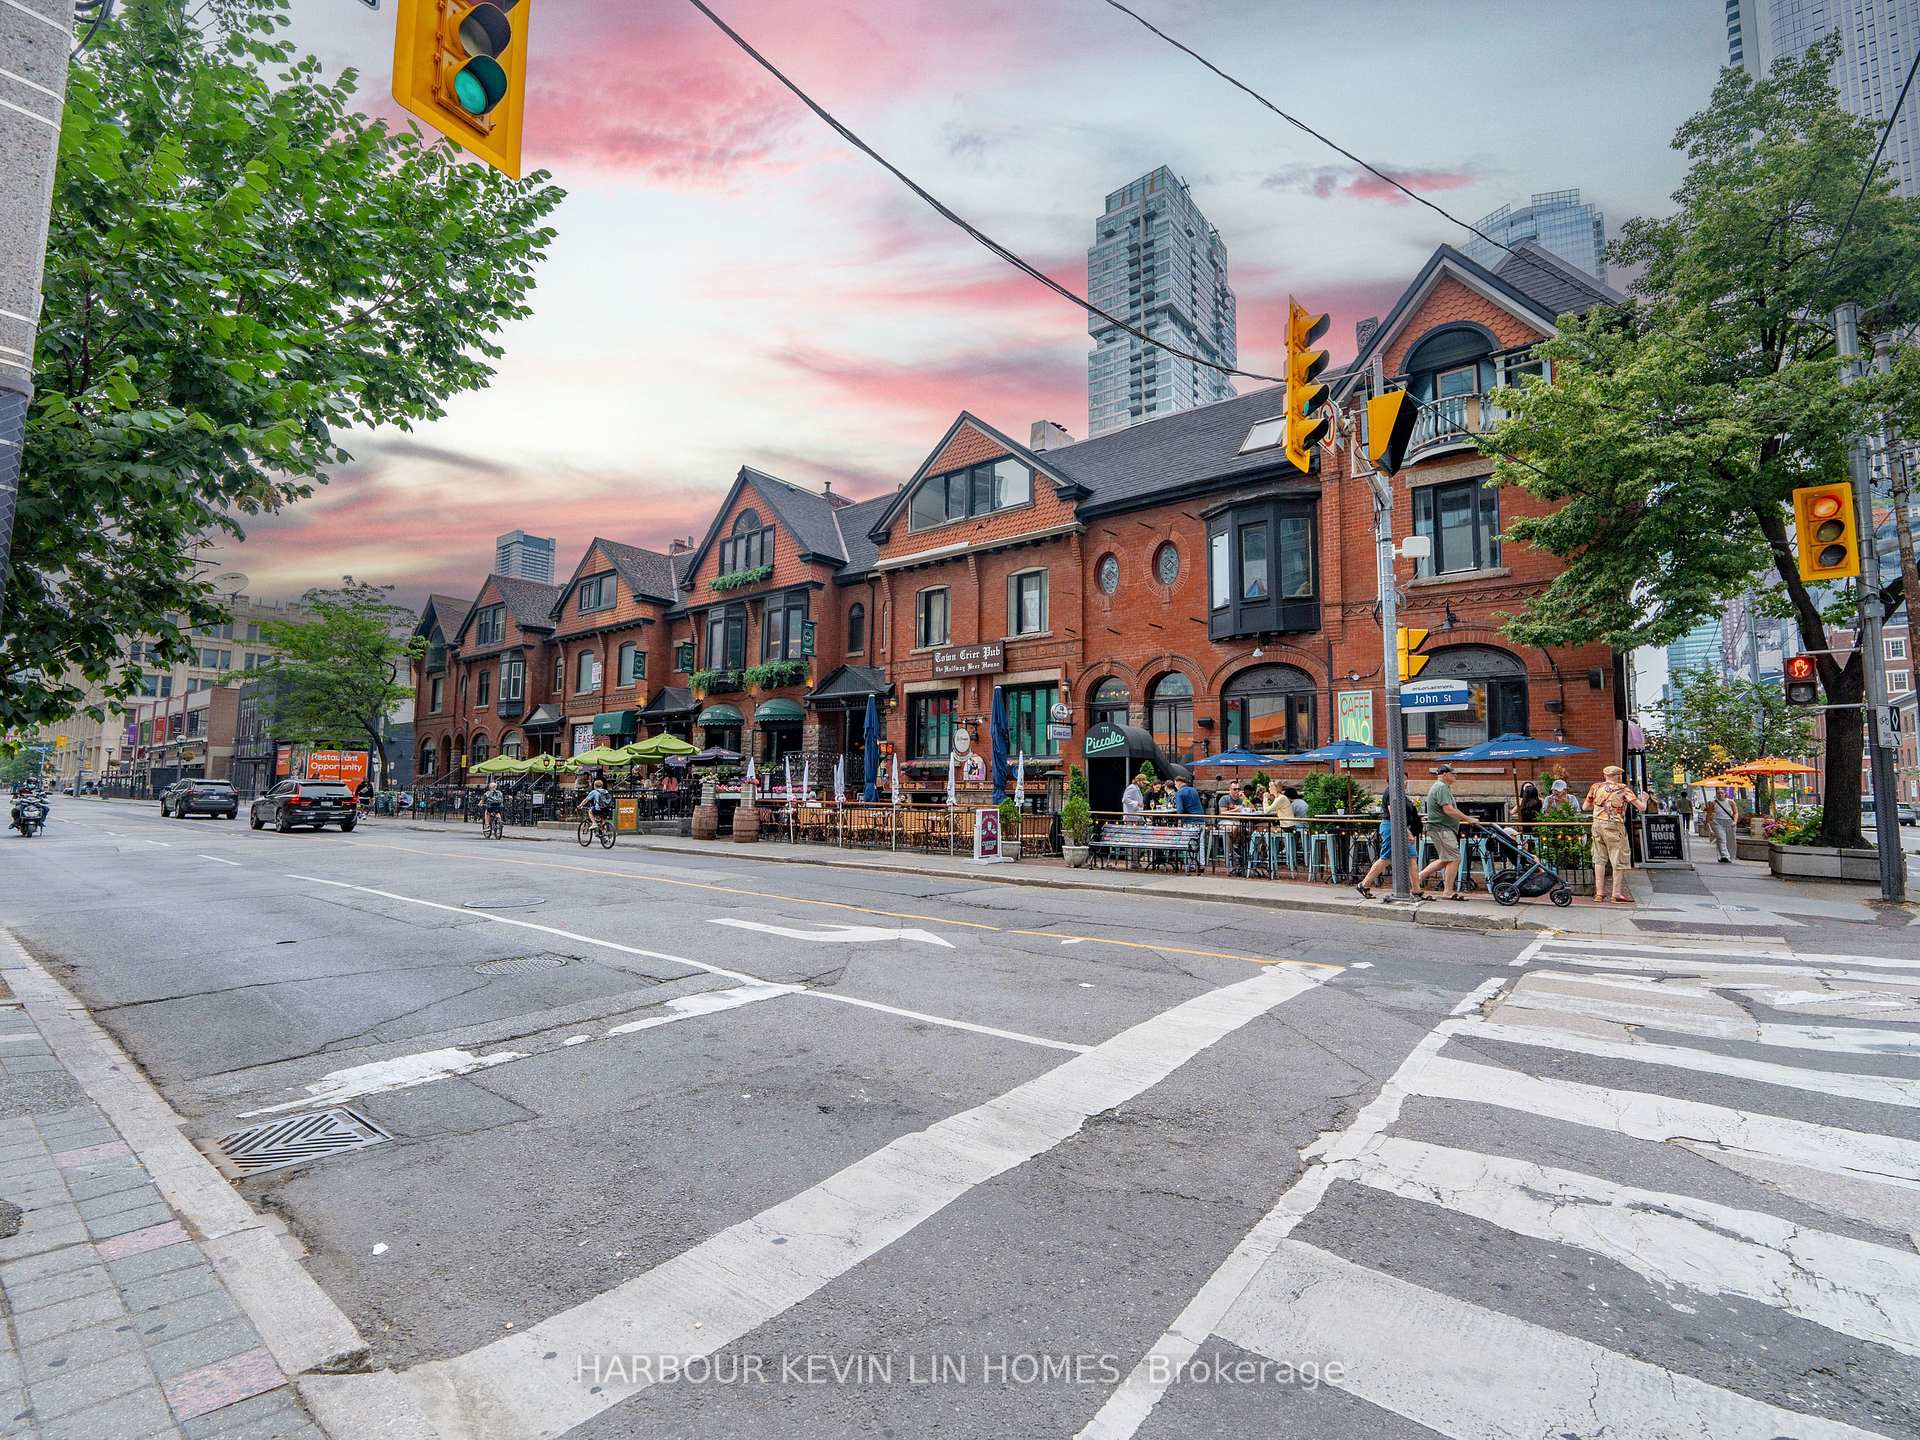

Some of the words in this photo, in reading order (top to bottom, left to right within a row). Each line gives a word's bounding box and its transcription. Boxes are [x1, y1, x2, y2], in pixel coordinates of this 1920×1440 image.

[935, 652, 957, 663] Town
[959, 649, 980, 660] Crier
[983, 645, 1001, 660] Pub
[967, 662, 980, 671] Beer
[981, 661, 1000, 671] House
[1415, 694, 1438, 704] John
[1443, 694, 1452, 702] St
[1342, 697, 1370, 719] CAFFE
[575, 726, 588, 735] FOR
[575, 734, 595, 744] LEASE
[1086, 731, 1125, 753] Piccolo
[1650, 823, 1675, 832] HAPPY
[1651, 831, 1676, 841] HOUR
